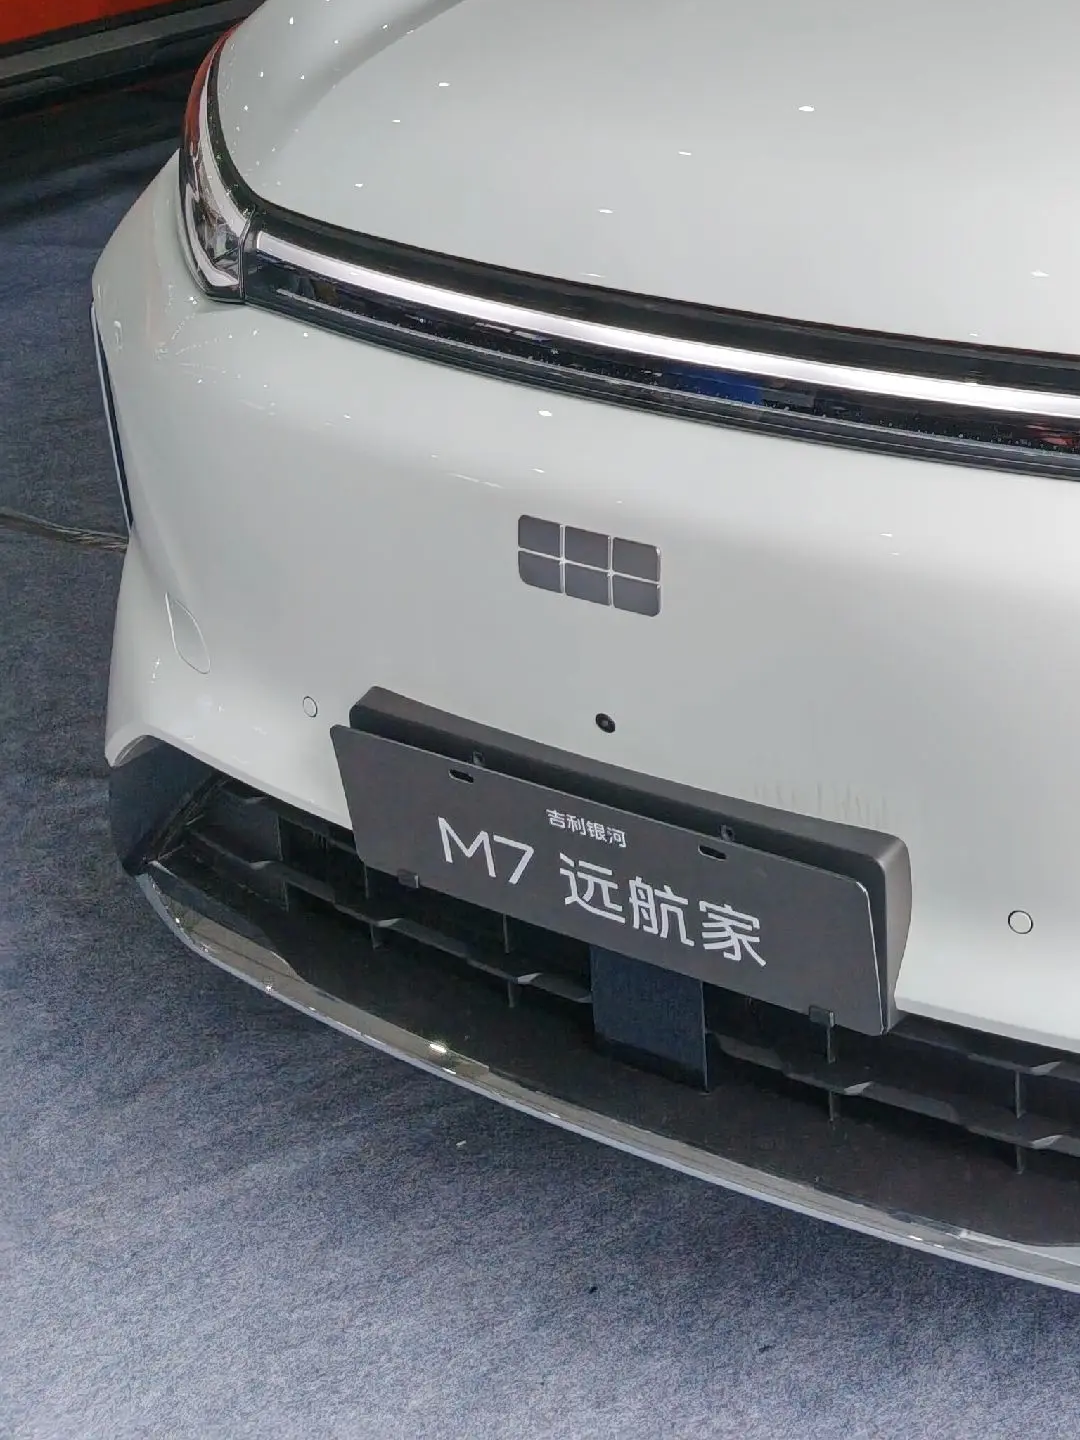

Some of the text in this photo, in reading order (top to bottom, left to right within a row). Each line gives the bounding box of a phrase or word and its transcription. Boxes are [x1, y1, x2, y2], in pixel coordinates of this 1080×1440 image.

[546, 809, 628, 848] 吉利银河
[437, 816, 767, 967] M7 远航家
